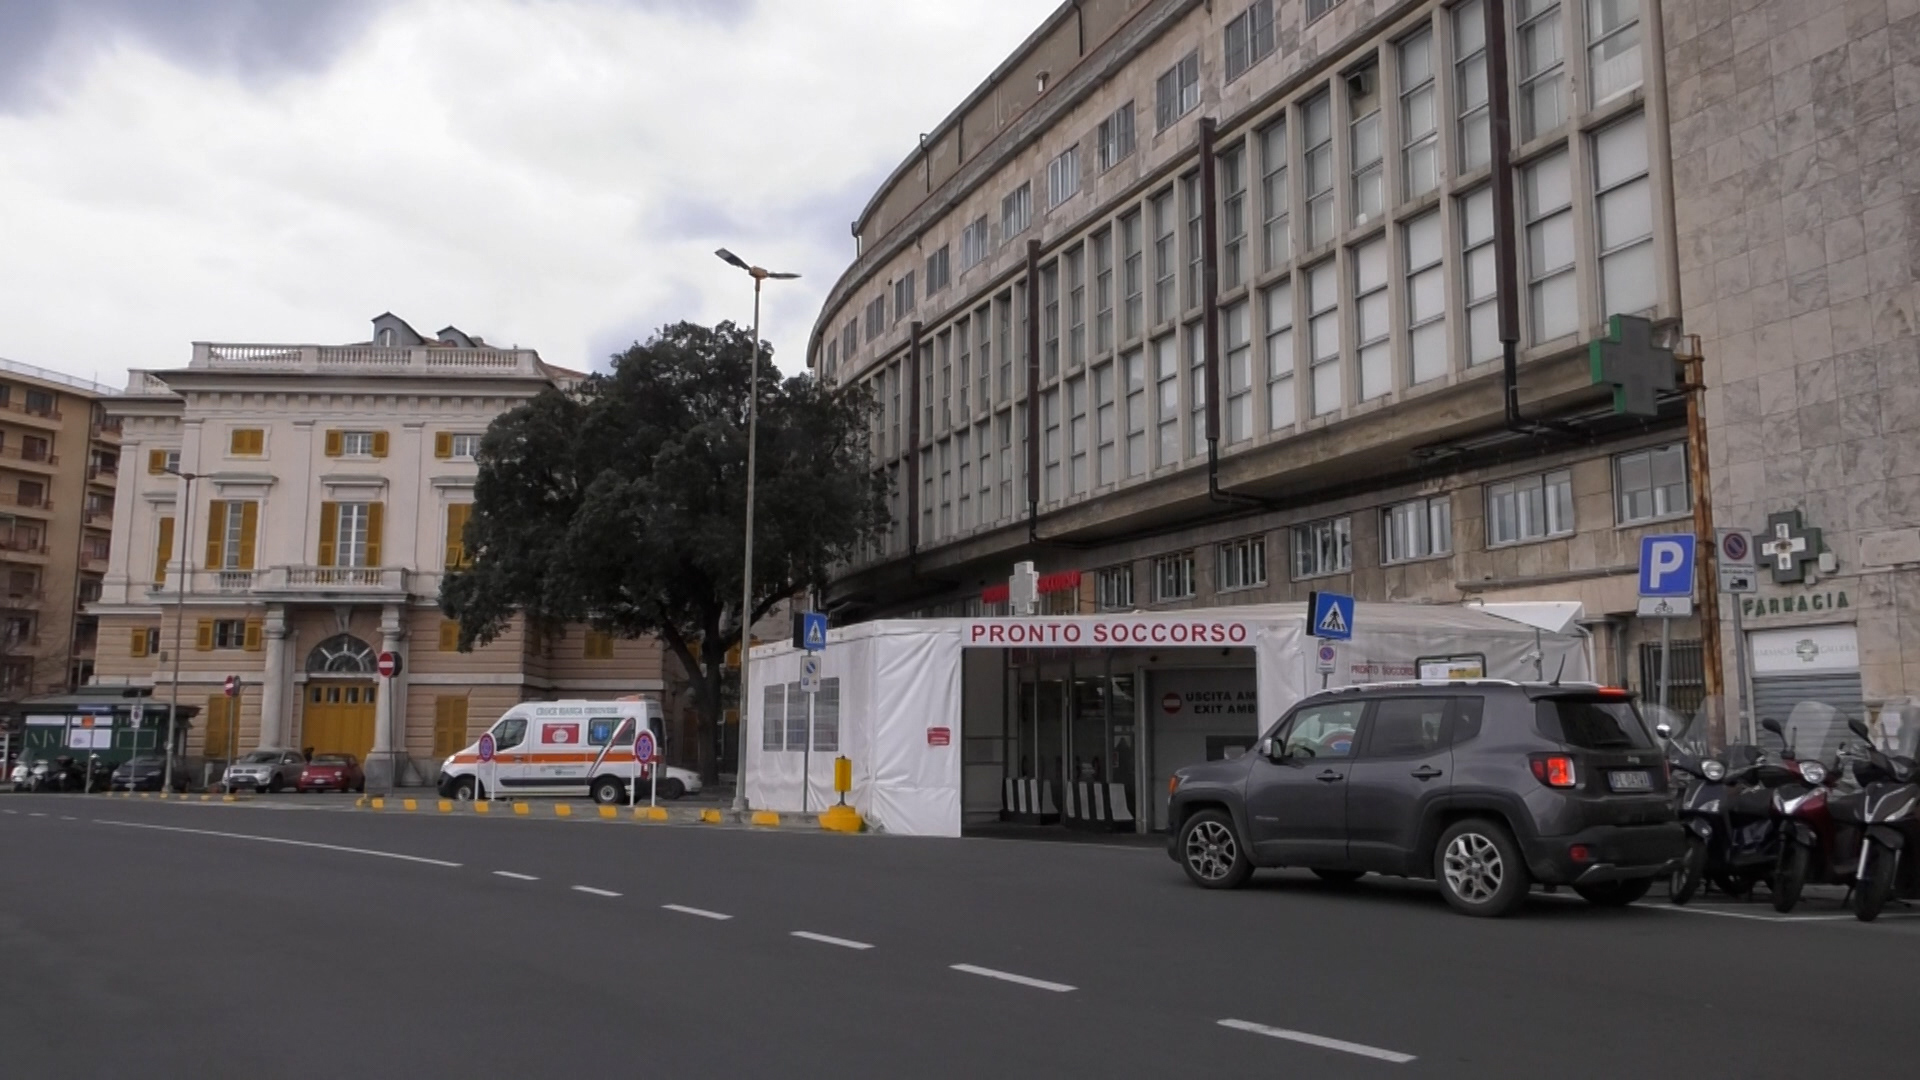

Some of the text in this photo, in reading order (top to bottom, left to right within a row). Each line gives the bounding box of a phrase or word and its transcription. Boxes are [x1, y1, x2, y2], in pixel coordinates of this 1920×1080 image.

[1649, 541, 1684, 588] P
[1743, 591, 1849, 616] FARMACIA
[971, 623, 1247, 644] PRONTO SOCCORSO
[1382, 665, 1416, 676] SOCCORS
[1185, 691, 1231, 702] USCITA
[1194, 705, 1223, 714] EXIT
